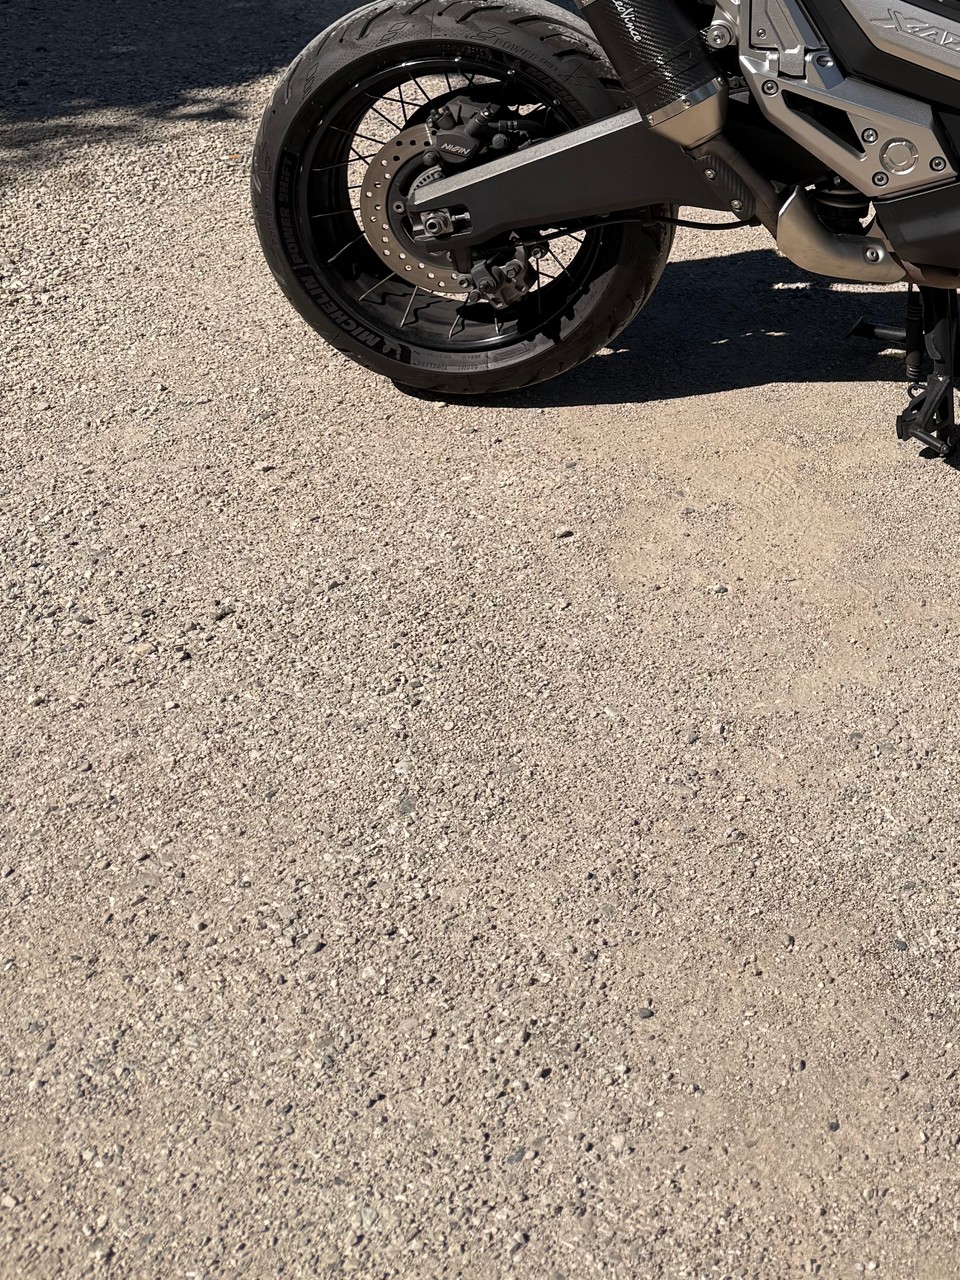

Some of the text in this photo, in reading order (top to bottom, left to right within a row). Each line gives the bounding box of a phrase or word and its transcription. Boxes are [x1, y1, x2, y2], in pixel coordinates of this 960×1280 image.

[441, 143, 471, 155] NISSIN
[279, 206, 304, 264] POWER
[300, 275, 381, 347] MICHELIN
